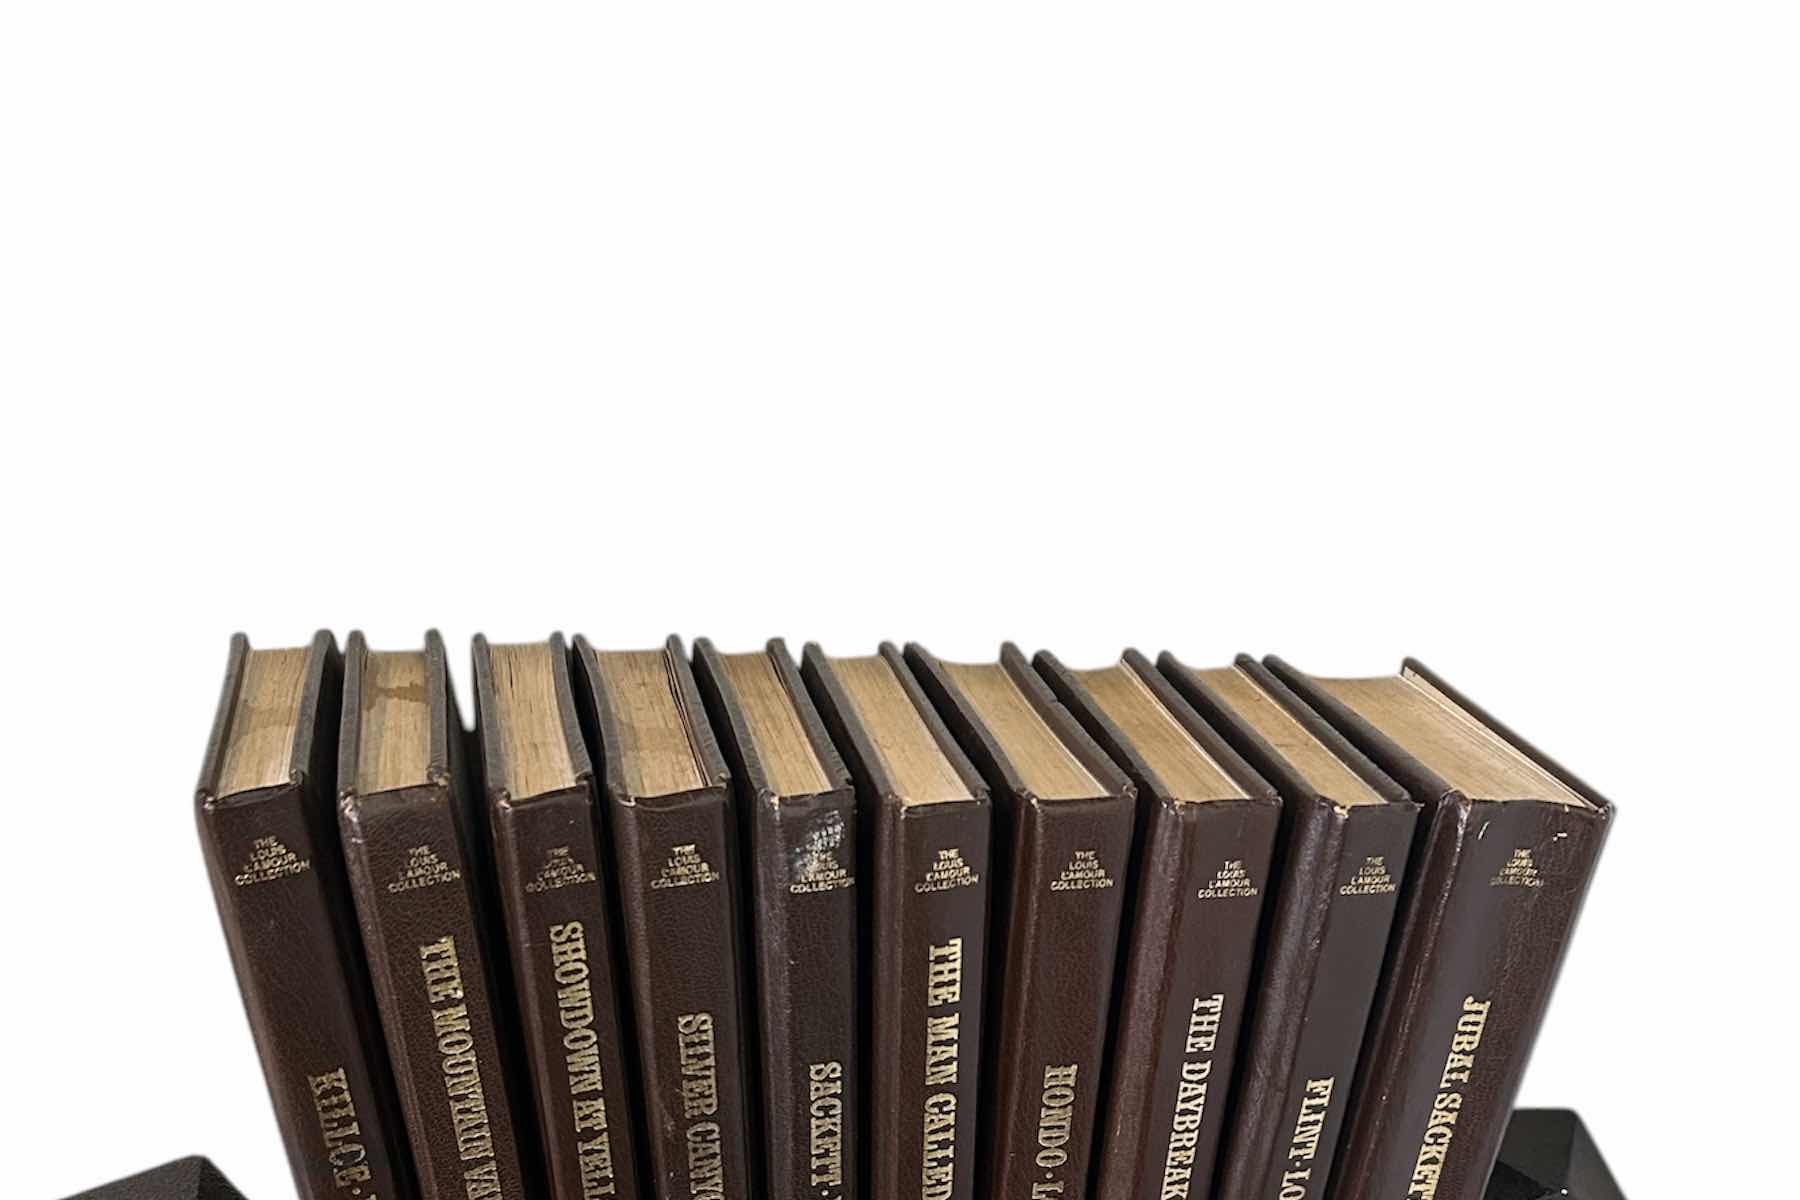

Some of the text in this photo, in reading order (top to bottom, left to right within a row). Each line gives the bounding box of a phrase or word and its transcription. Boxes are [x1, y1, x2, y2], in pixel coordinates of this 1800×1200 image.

[672, 844, 695, 855] THE
[938, 848, 960, 859] THE
[1075, 850, 1096, 860] THE
[933, 858, 964, 871] LOUIS
[1069, 860, 1098, 870] LOUIS
[1224, 860, 1242, 870] THE
[1359, 866, 1386, 875] LOUIS
[1367, 856, 1384, 865] THE
[651, 871, 720, 888] COLLECTION
[914, 873, 979, 893] COLLECTION
[1051, 878, 1114, 891] COLLECTION
[1217, 870, 1246, 879] LOUIS
[1198, 887, 1257, 898] COLLECTION
[1340, 884, 1395, 895] COLLECTION
[420, 935, 464, 1003] THE
[928, 937, 962, 1007] THE
[550, 920, 602, 1094] SHOWDOWN
[1185, 994, 1224, 1053] THE
[925, 1012, 959, 1085] MAN
[1440, 995, 1491, 1088] JUBAL
[678, 1012, 718, 1119] SILVER
[432, 1003, 494, 1160] MOUNTAIN
[573, 1097, 607, 1132] AT
[809, 1061, 842, 1186] SACKETT
[1036, 1064, 1078, 1168] HONDO
[1288, 1076, 1335, 1160] FLINT
[307, 1067, 371, 1188] KILLOE
